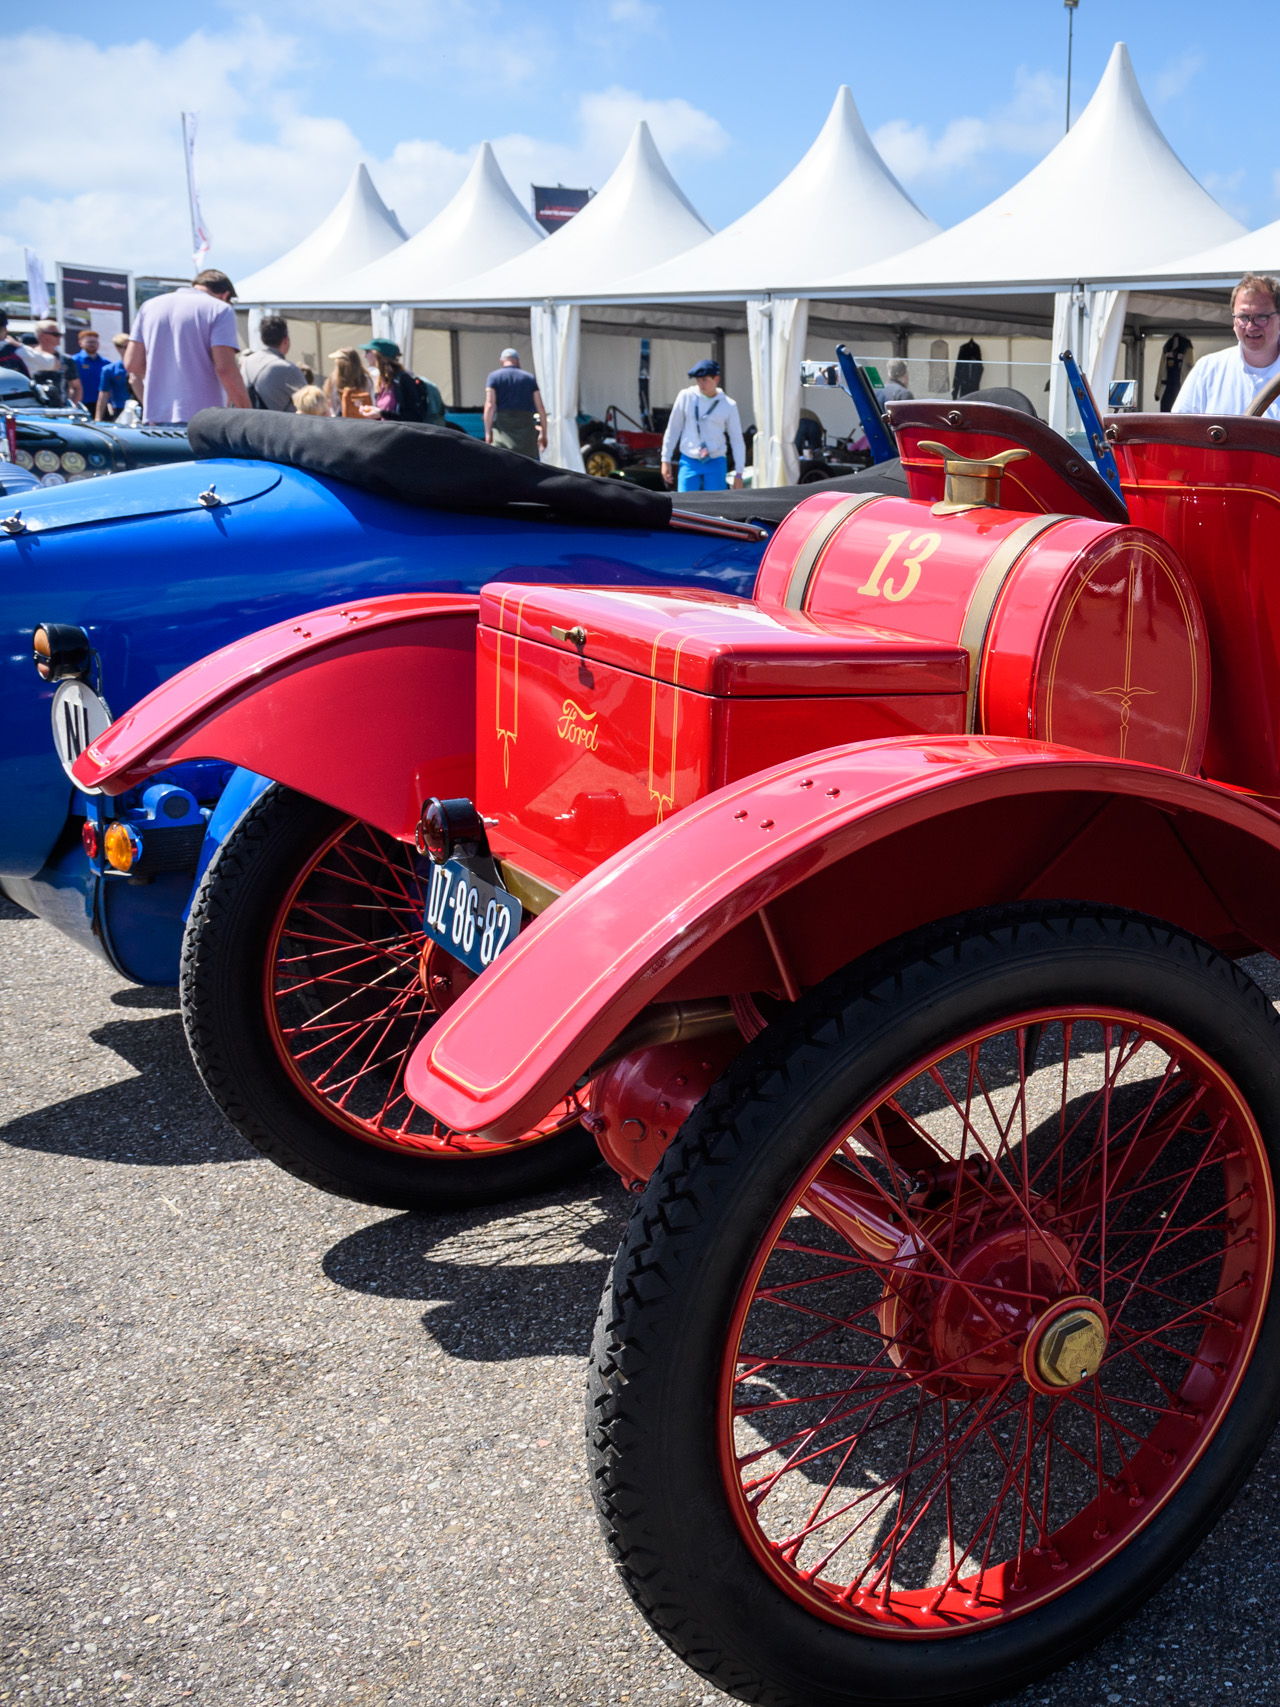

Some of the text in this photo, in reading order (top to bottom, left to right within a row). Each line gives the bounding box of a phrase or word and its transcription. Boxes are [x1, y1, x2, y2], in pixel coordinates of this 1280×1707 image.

[857, 530, 942, 602] 13
[557, 699, 599, 752] Ford
[427, 864, 511, 966] DZ-86-82
